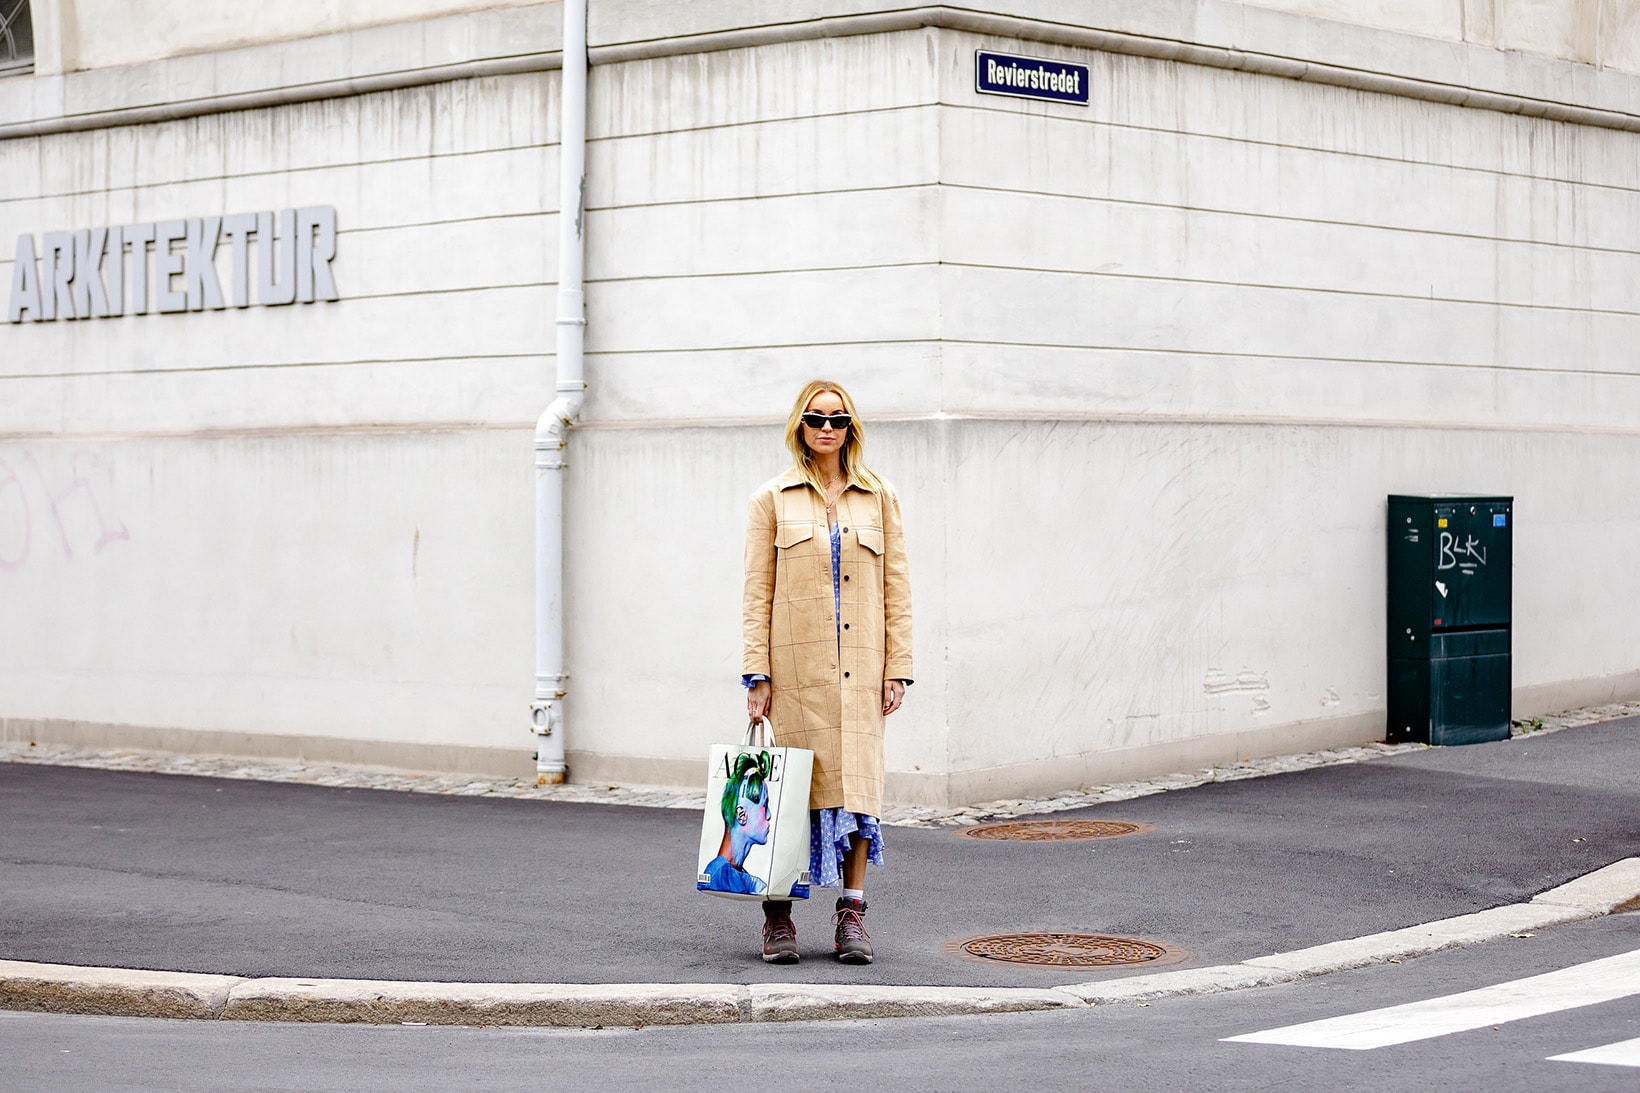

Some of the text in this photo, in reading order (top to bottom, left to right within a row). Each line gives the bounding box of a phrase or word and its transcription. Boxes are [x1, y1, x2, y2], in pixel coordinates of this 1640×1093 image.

[987, 58, 1080, 95] Revierstredet
[8, 204, 339, 323] ARKITEKTUR
[711, 751, 783, 783] ACE
